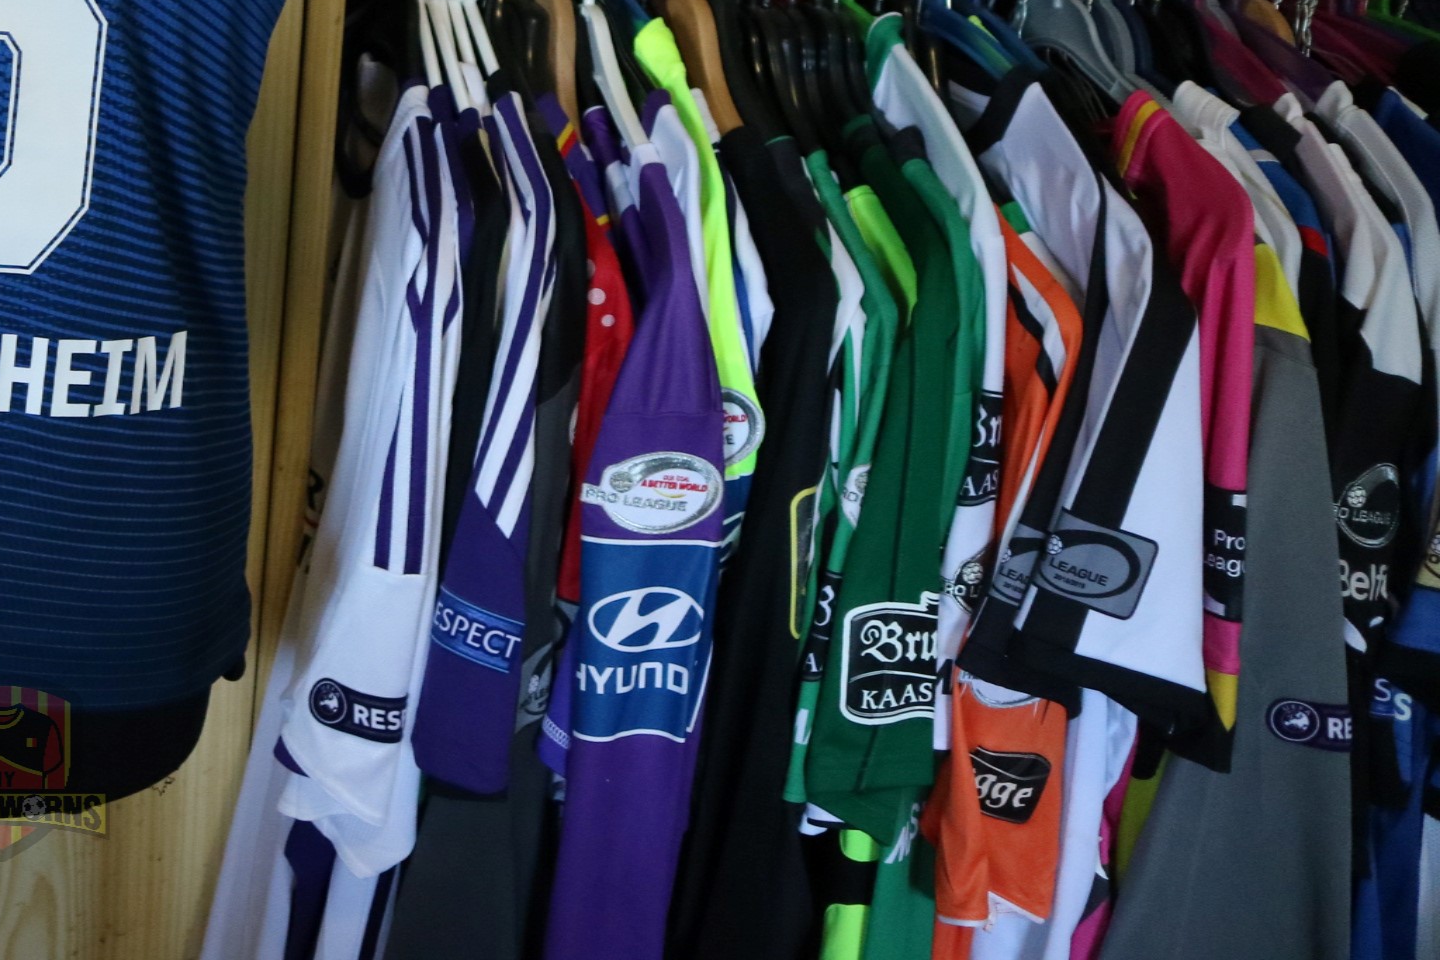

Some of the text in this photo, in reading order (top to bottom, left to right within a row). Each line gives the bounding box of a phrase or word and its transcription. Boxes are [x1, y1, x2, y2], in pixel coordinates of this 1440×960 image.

[585, 488, 689, 512] PRO LEAGUE
[648, 480, 677, 490] BETTER
[679, 483, 709, 493] WORLD
[1214, 528, 1245, 551] Pro
[1049, 557, 1109, 587] LEAGUE
[433, 601, 522, 658] ESPECT
[861, 683, 933, 710] KAAS
[973, 768, 1034, 809] gge
